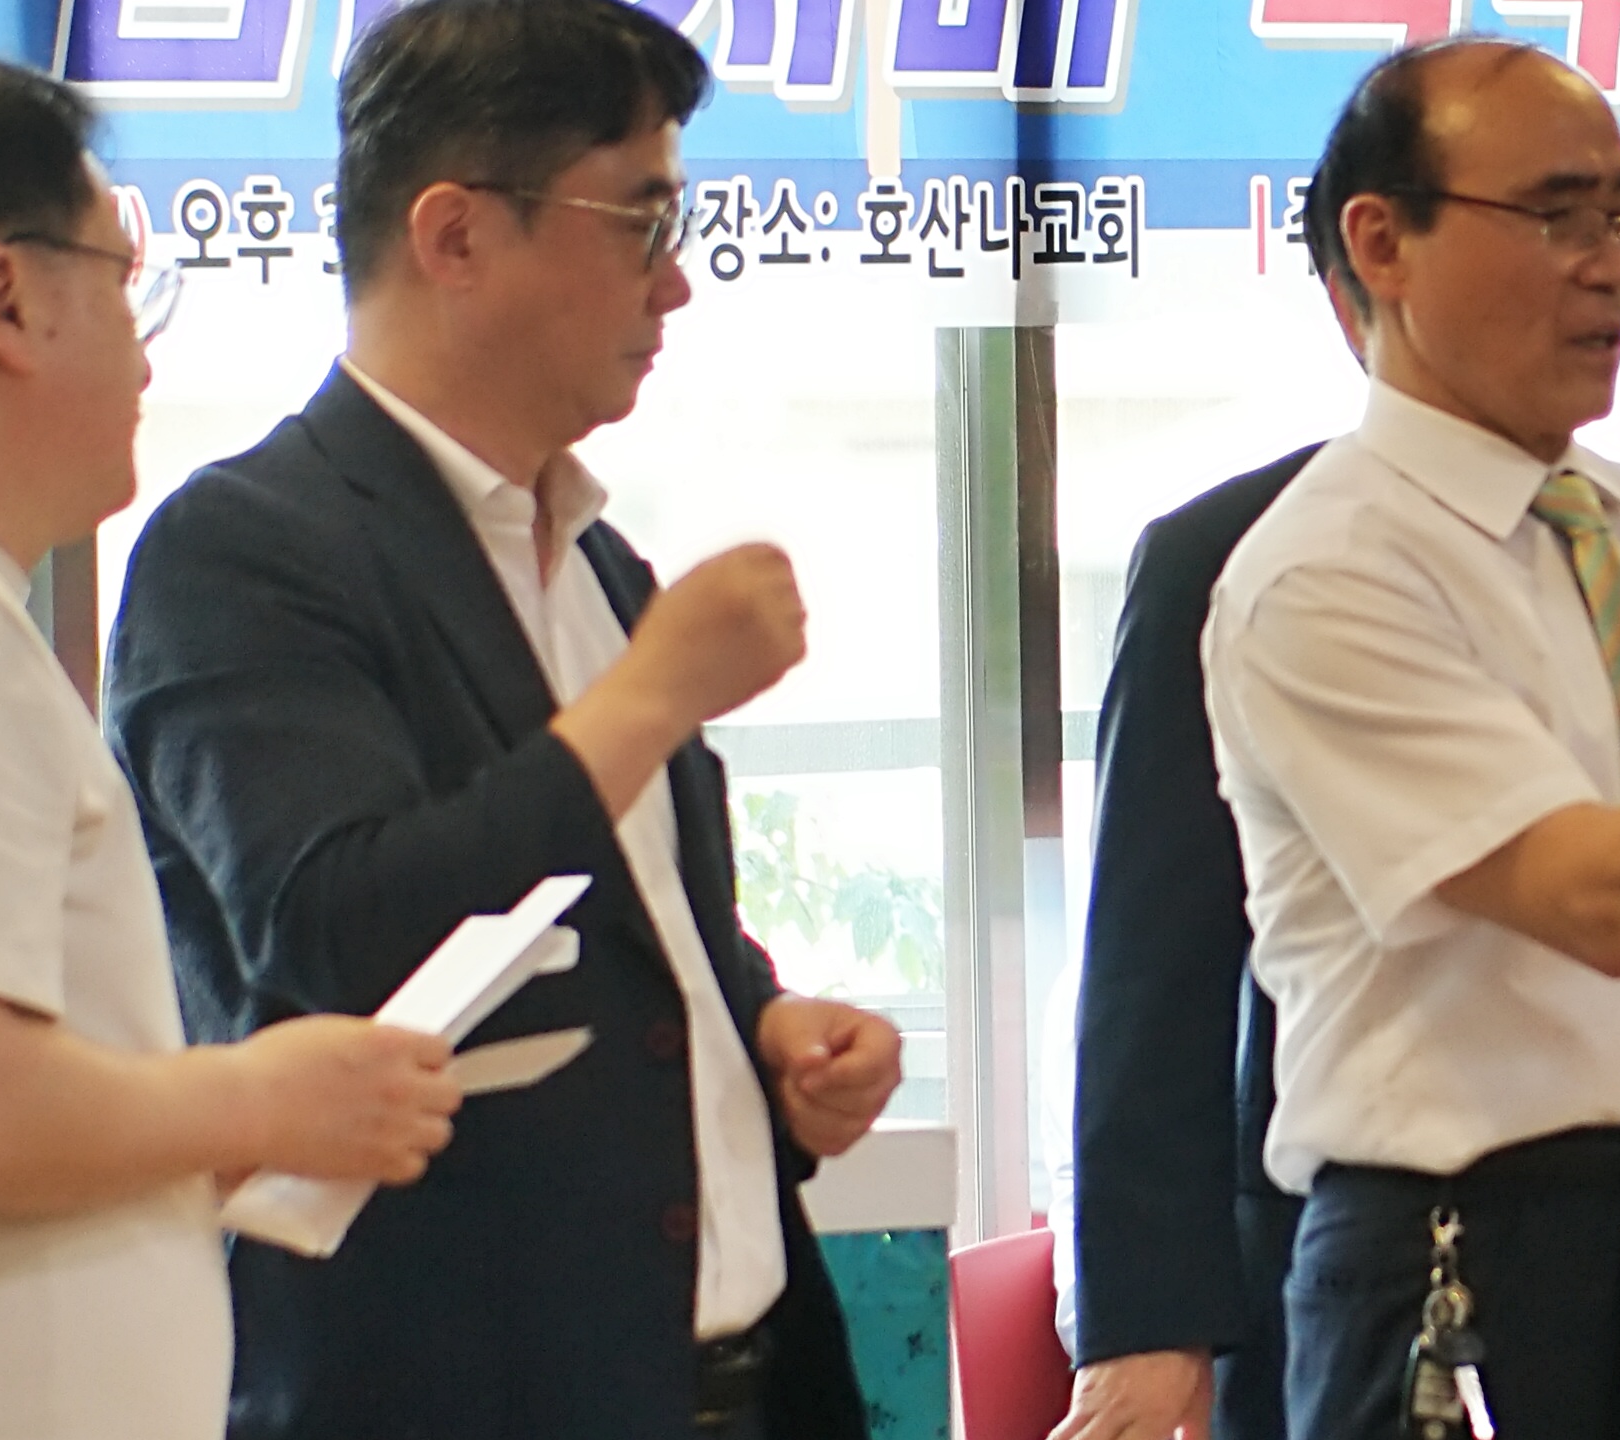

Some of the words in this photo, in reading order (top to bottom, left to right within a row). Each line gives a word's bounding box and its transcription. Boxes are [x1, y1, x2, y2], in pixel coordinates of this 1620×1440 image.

[175, 184, 293, 285] 오후
[700, 184, 831, 281] 장소:
[859, 181, 1139, 280] 호산나교회
